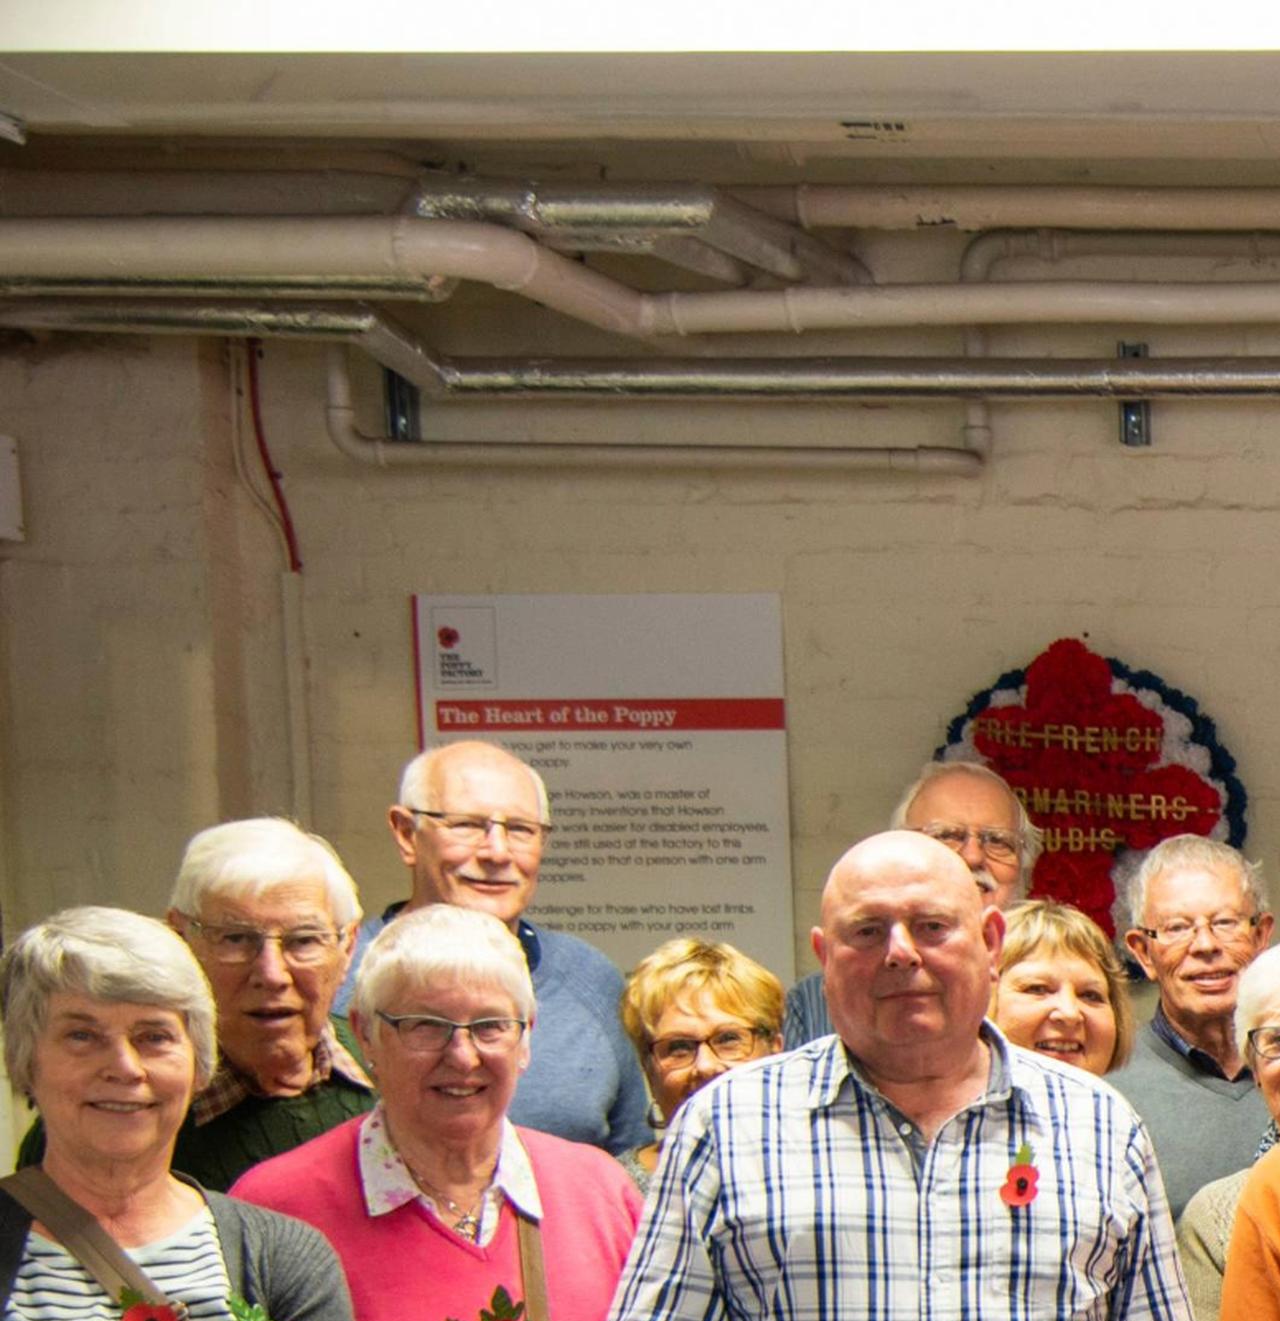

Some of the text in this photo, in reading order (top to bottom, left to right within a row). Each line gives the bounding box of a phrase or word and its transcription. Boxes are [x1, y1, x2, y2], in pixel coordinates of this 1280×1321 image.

[439, 706, 677, 727] The Heart of the Poppy
[1043, 724, 1161, 753] FRENCH
[511, 742, 693, 751] you get to make your very own
[617, 789, 641, 800] was
[655, 789, 694, 800] master
[553, 807, 724, 817] many inventions that Howson
[562, 823, 588, 833] work
[592, 823, 628, 833] easier
[631, 823, 646, 833] for
[650, 823, 699, 833] disabled
[551, 839, 570, 849] are
[592, 839, 621, 849] used
[662, 839, 704, 849] factory
[541, 855, 589, 867] esigned
[592, 855, 605, 867] so
[608, 855, 631, 867] that
[646, 855, 686, 867] person
[689, 855, 713, 867] with
[716, 855, 739, 867] one
[742, 855, 766, 867] arm
[588, 904, 603, 915] for
[606, 904, 637, 915] those
[641, 904, 666, 915] who
[669, 904, 698, 915] have
[701, 904, 721, 915] lost
[567, 921, 576, 932] a
[578, 921, 616, 932] poppy
[621, 921, 643, 932] with
[647, 921, 671, 932] your
[675, 921, 708, 932] good
